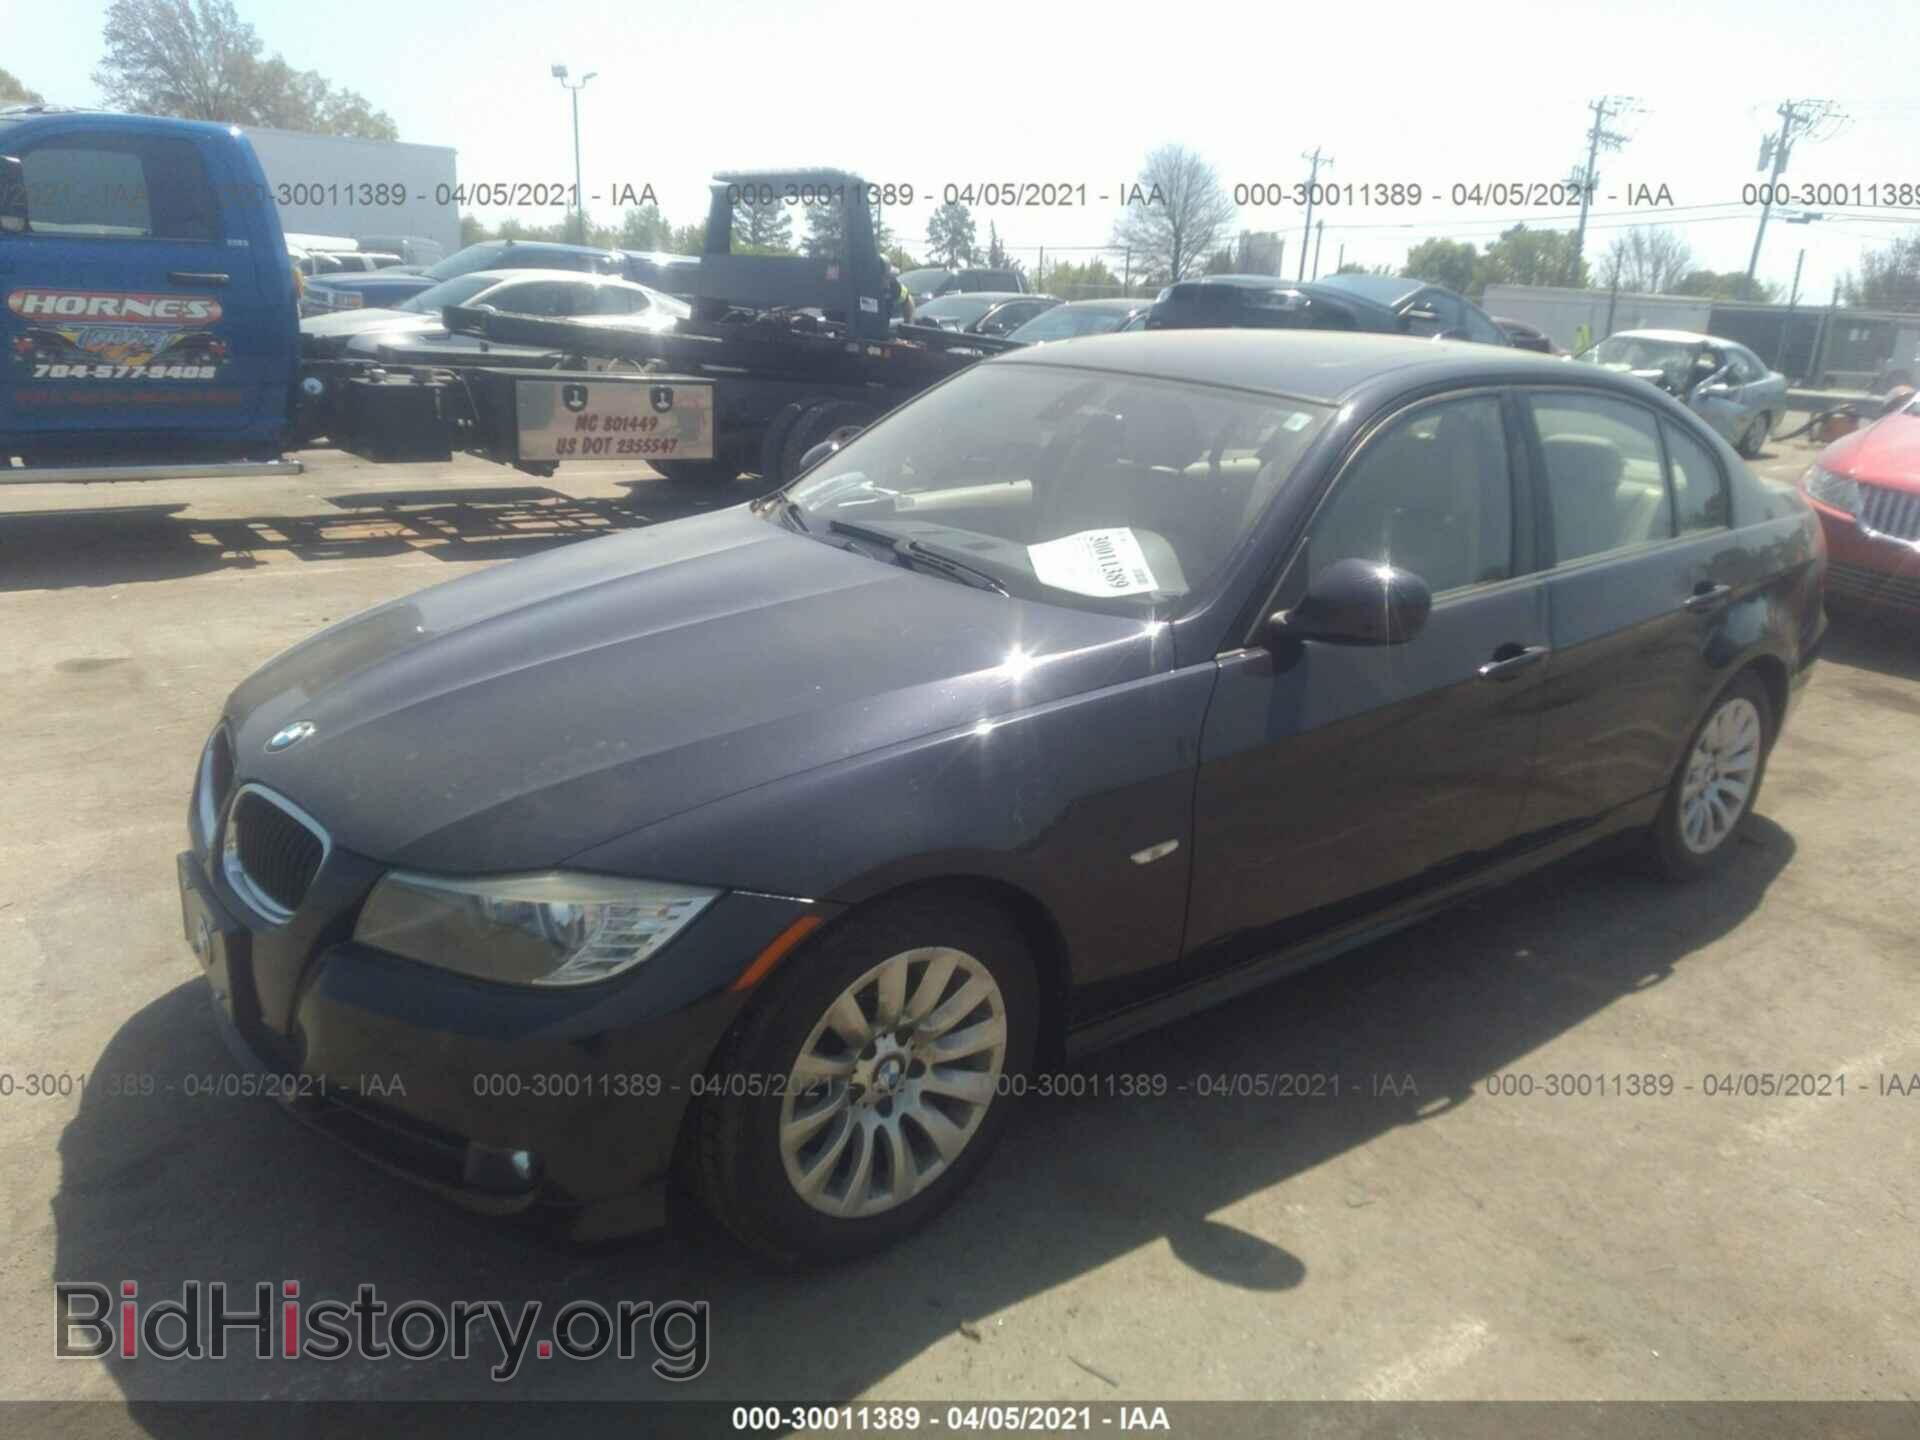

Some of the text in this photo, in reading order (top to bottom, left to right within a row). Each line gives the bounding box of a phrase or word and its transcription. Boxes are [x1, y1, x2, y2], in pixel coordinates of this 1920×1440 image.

[575, 413, 659, 432] MC 801449
[555, 436, 679, 455] US DOT 2355547
[1088, 535, 1131, 588] 30011389
